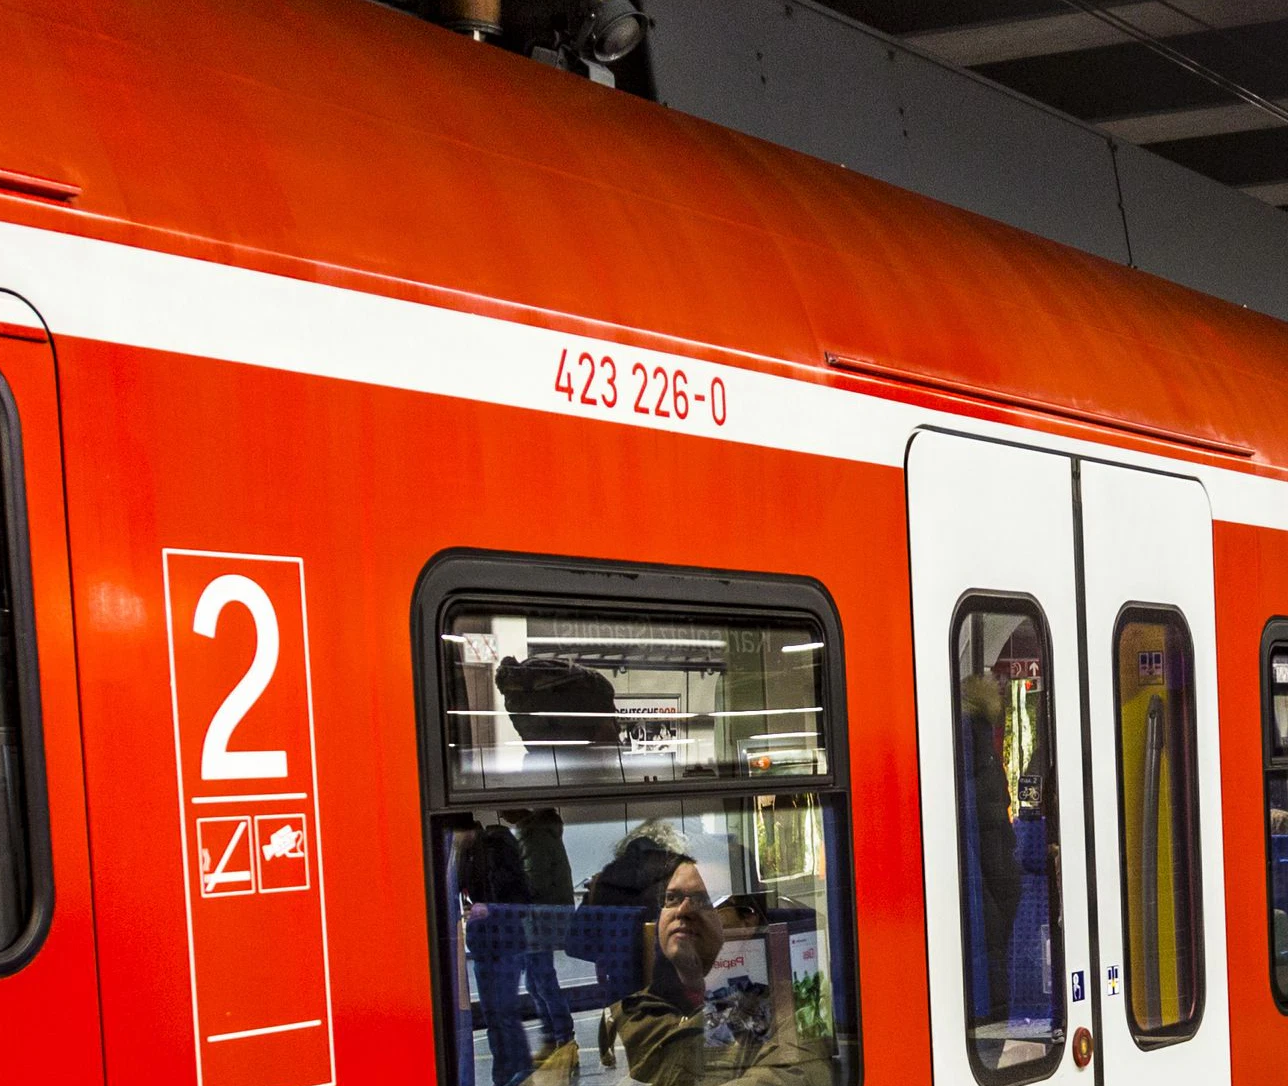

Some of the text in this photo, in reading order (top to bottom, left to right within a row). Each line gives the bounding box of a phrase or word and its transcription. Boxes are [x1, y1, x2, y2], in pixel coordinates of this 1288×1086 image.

[554, 348, 726, 427] 423 226-0
[192, 574, 288, 781] 2
